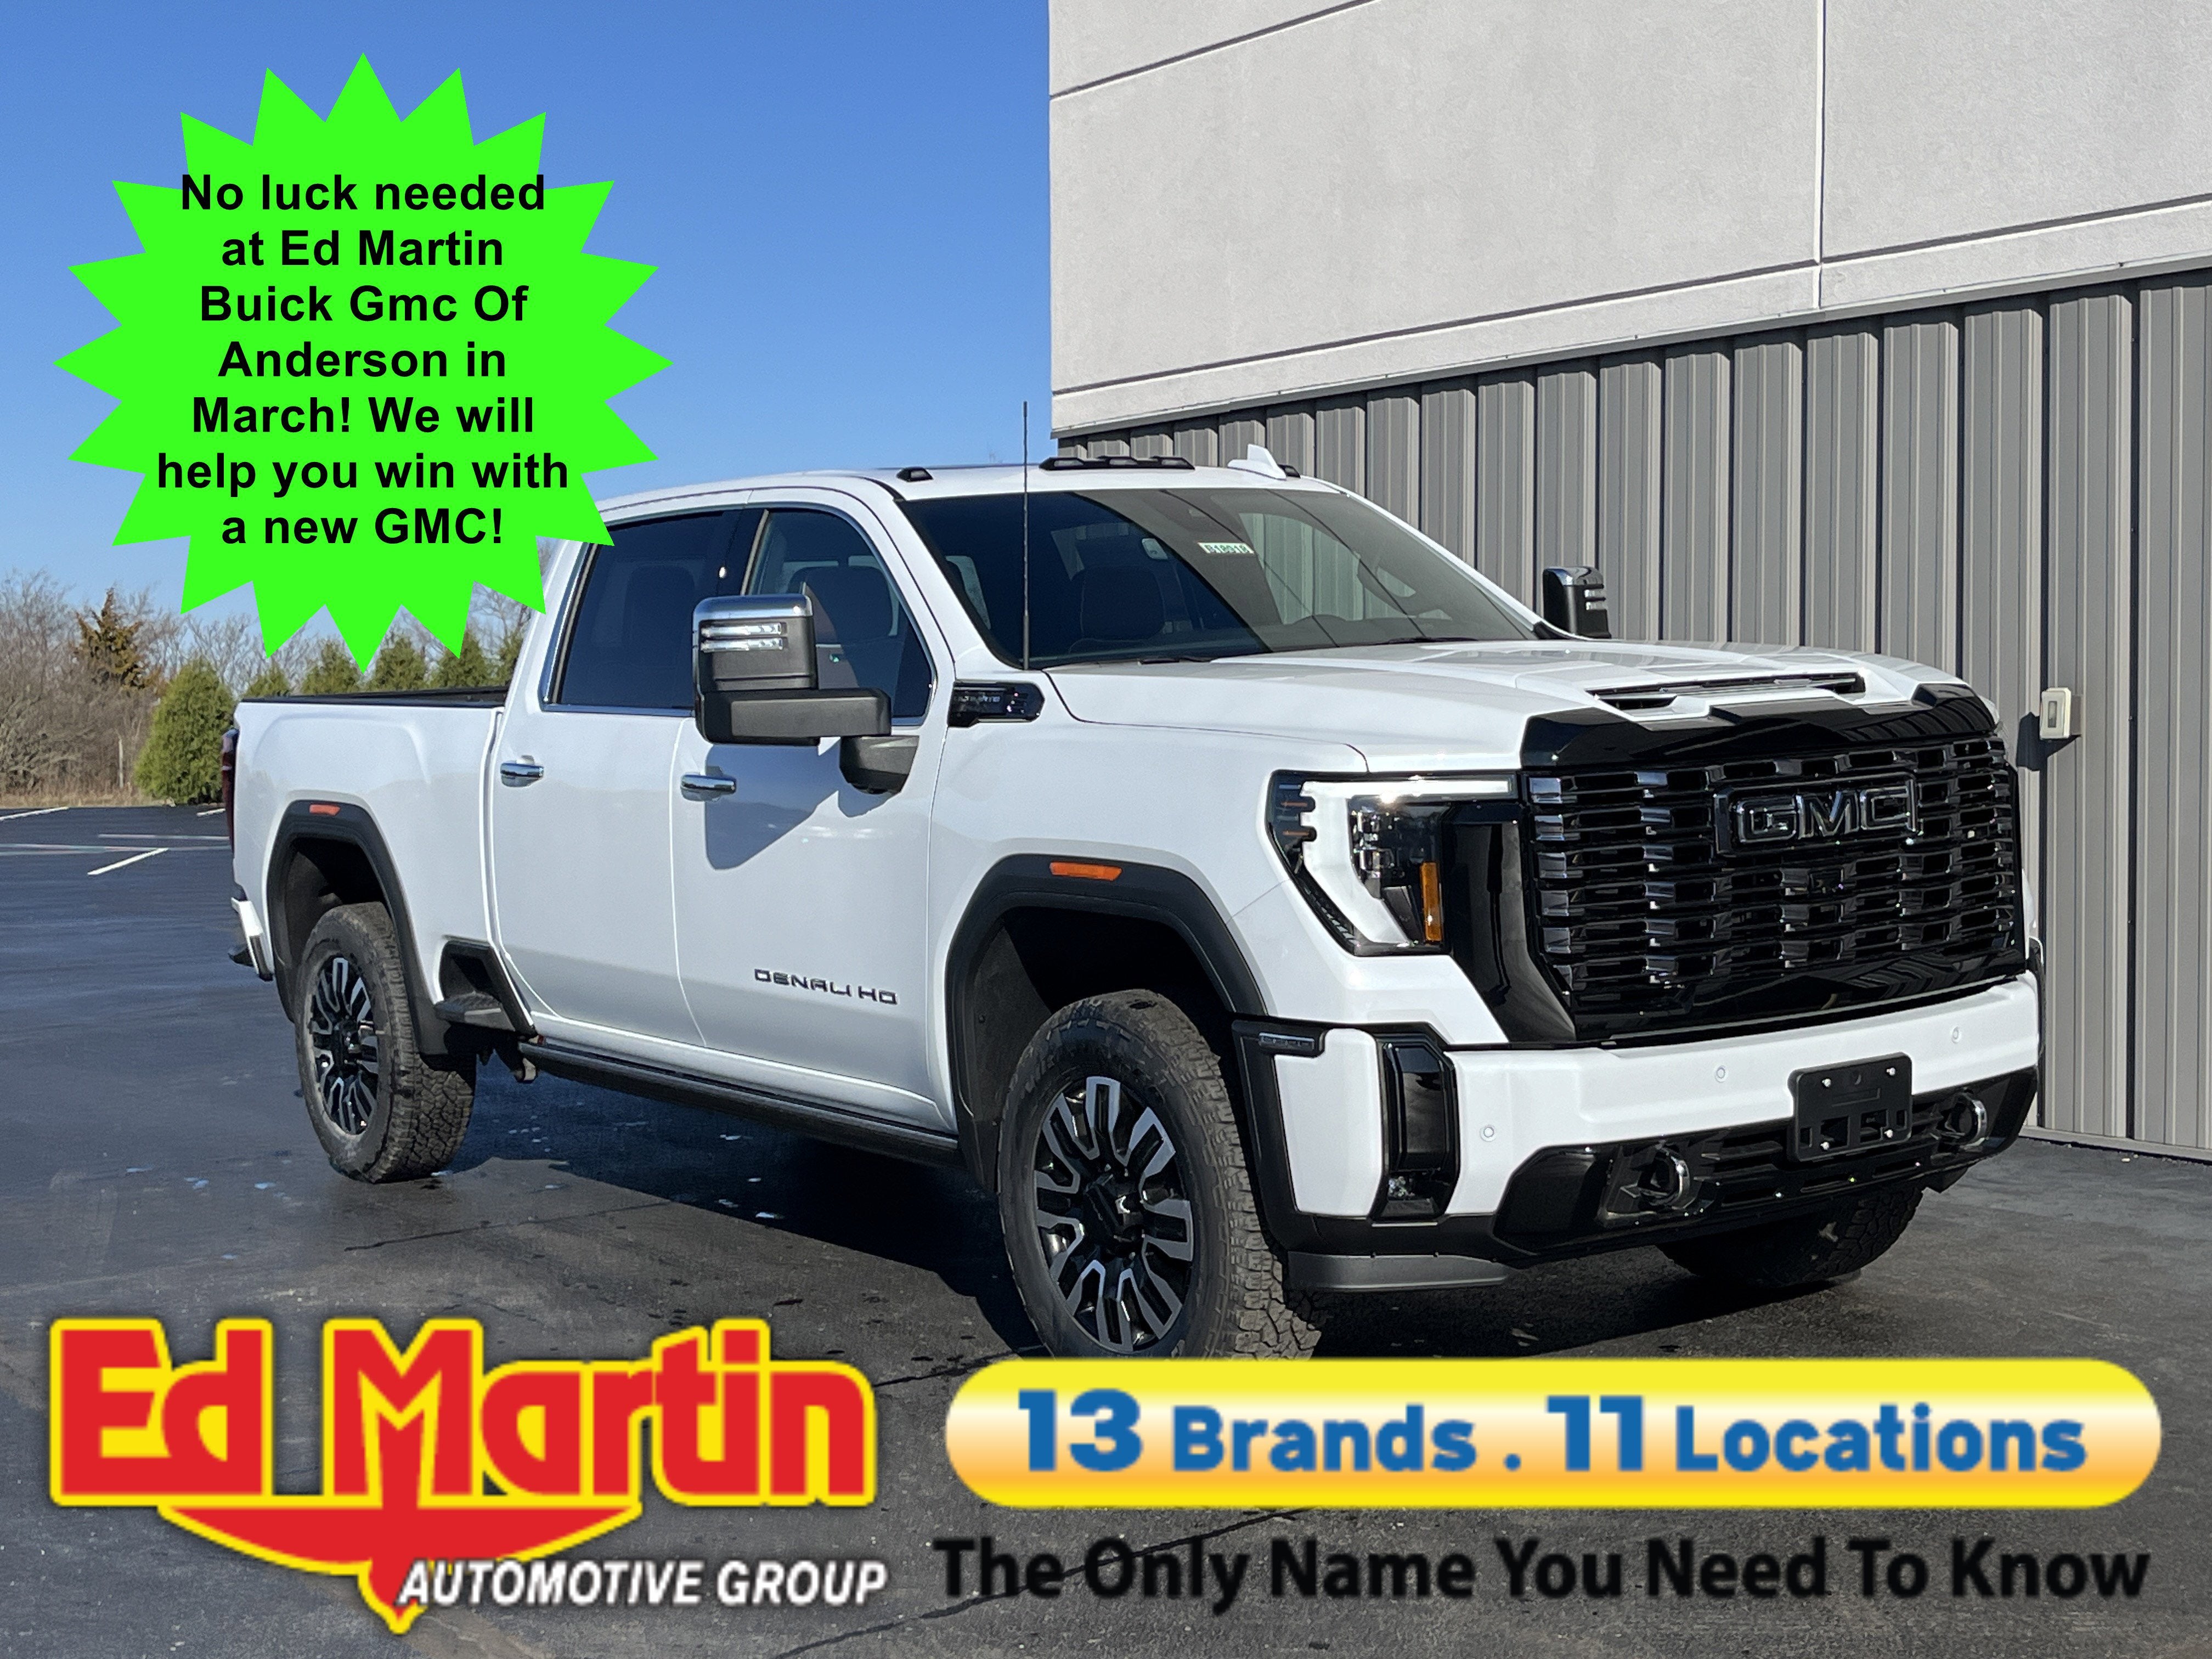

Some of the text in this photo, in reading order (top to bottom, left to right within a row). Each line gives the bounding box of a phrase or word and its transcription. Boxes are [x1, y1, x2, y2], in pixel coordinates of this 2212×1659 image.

[1737, 784, 1909, 843] GMC
[754, 968, 898, 1005] DENALI HD
